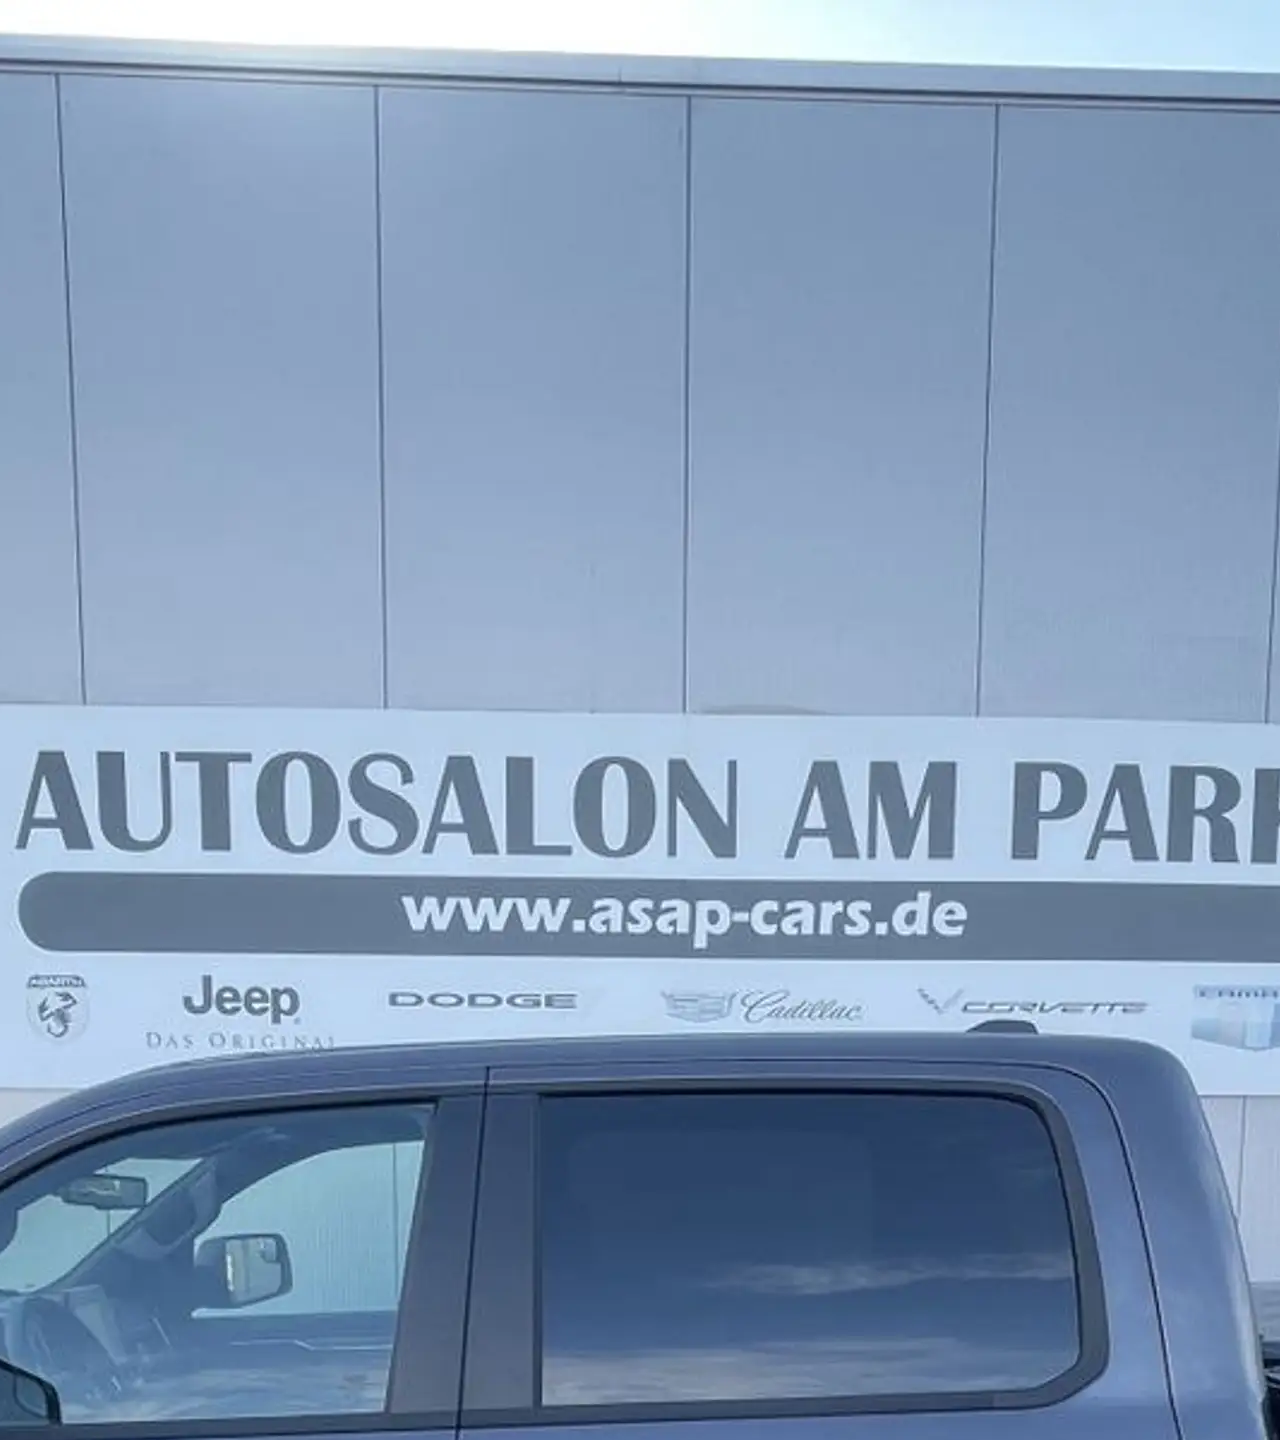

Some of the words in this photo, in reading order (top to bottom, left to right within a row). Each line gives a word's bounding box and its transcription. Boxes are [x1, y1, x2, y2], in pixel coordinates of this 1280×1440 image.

[15, 750, 738, 859] AUTOSALON
[784, 760, 958, 861] AM
[402, 891, 968, 949] www.asap-cars.de
[182, 974, 300, 1025] Jeep
[388, 991, 578, 1010] DODGE
[739, 989, 864, 1024] Cadillac
